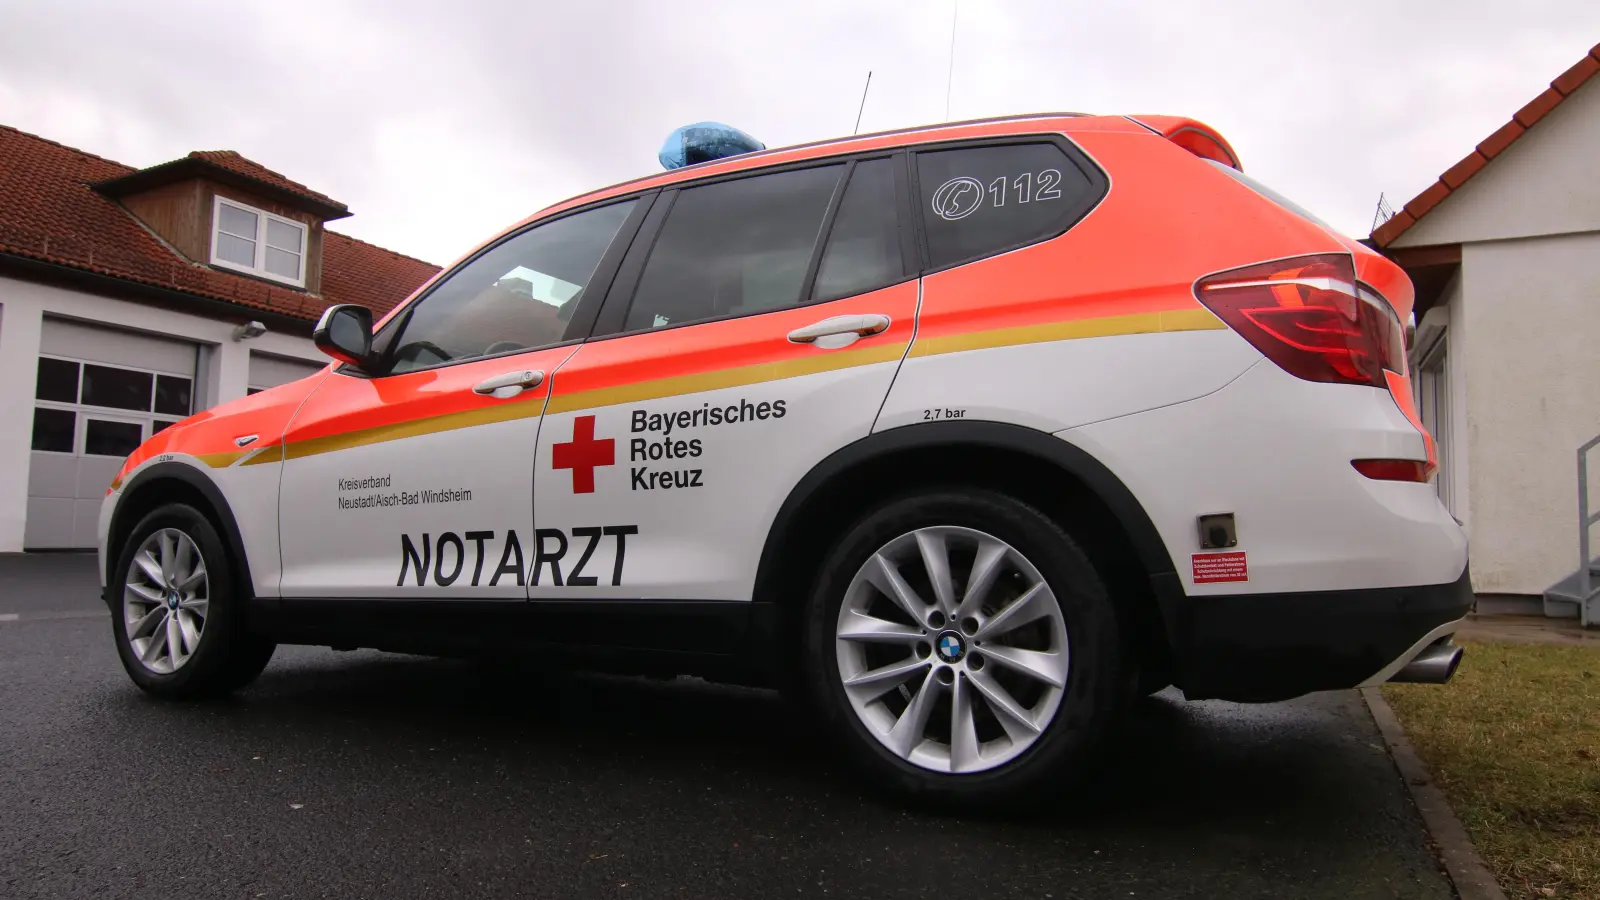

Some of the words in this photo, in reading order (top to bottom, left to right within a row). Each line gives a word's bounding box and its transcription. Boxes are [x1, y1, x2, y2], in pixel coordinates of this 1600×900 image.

[989, 169, 1061, 207] 112
[631, 399, 787, 435] Bayerisches
[923, 408, 941, 420] 2,7
[945, 408, 966, 418] bar
[630, 437, 703, 461] Rotes
[338, 474, 391, 491] Kreisverband
[631, 466, 704, 490] Kreuz
[338, 492, 419, 510] Neustadt/Aisch-Bad
[420, 488, 472, 504] Windsheim
[396, 525, 638, 586] NOTARZT
